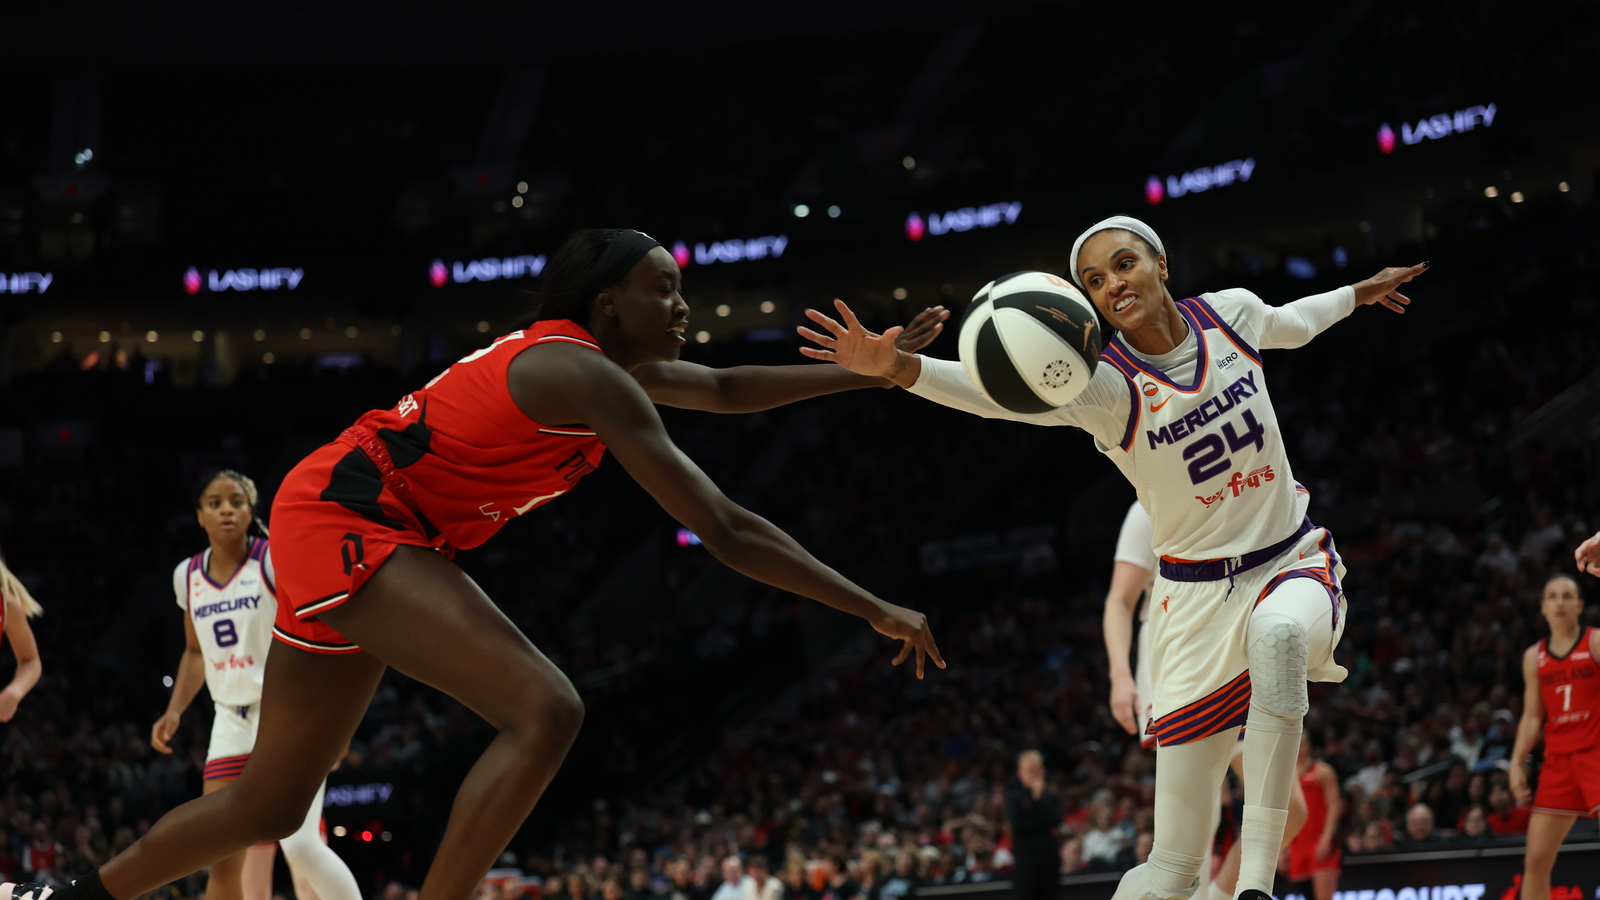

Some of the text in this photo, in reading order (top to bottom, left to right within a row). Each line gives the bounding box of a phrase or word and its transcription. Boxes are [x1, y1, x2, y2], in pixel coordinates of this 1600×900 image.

[1401, 102, 1495, 144] LASHIFY
[208, 267, 304, 291] LASHIFY
[1146, 369, 1258, 450] MERCURY
[1182, 408, 1265, 485] 24
[194, 595, 260, 620] MERCURY
[213, 619, 238, 647] 8
[1555, 684, 1572, 711] 7
